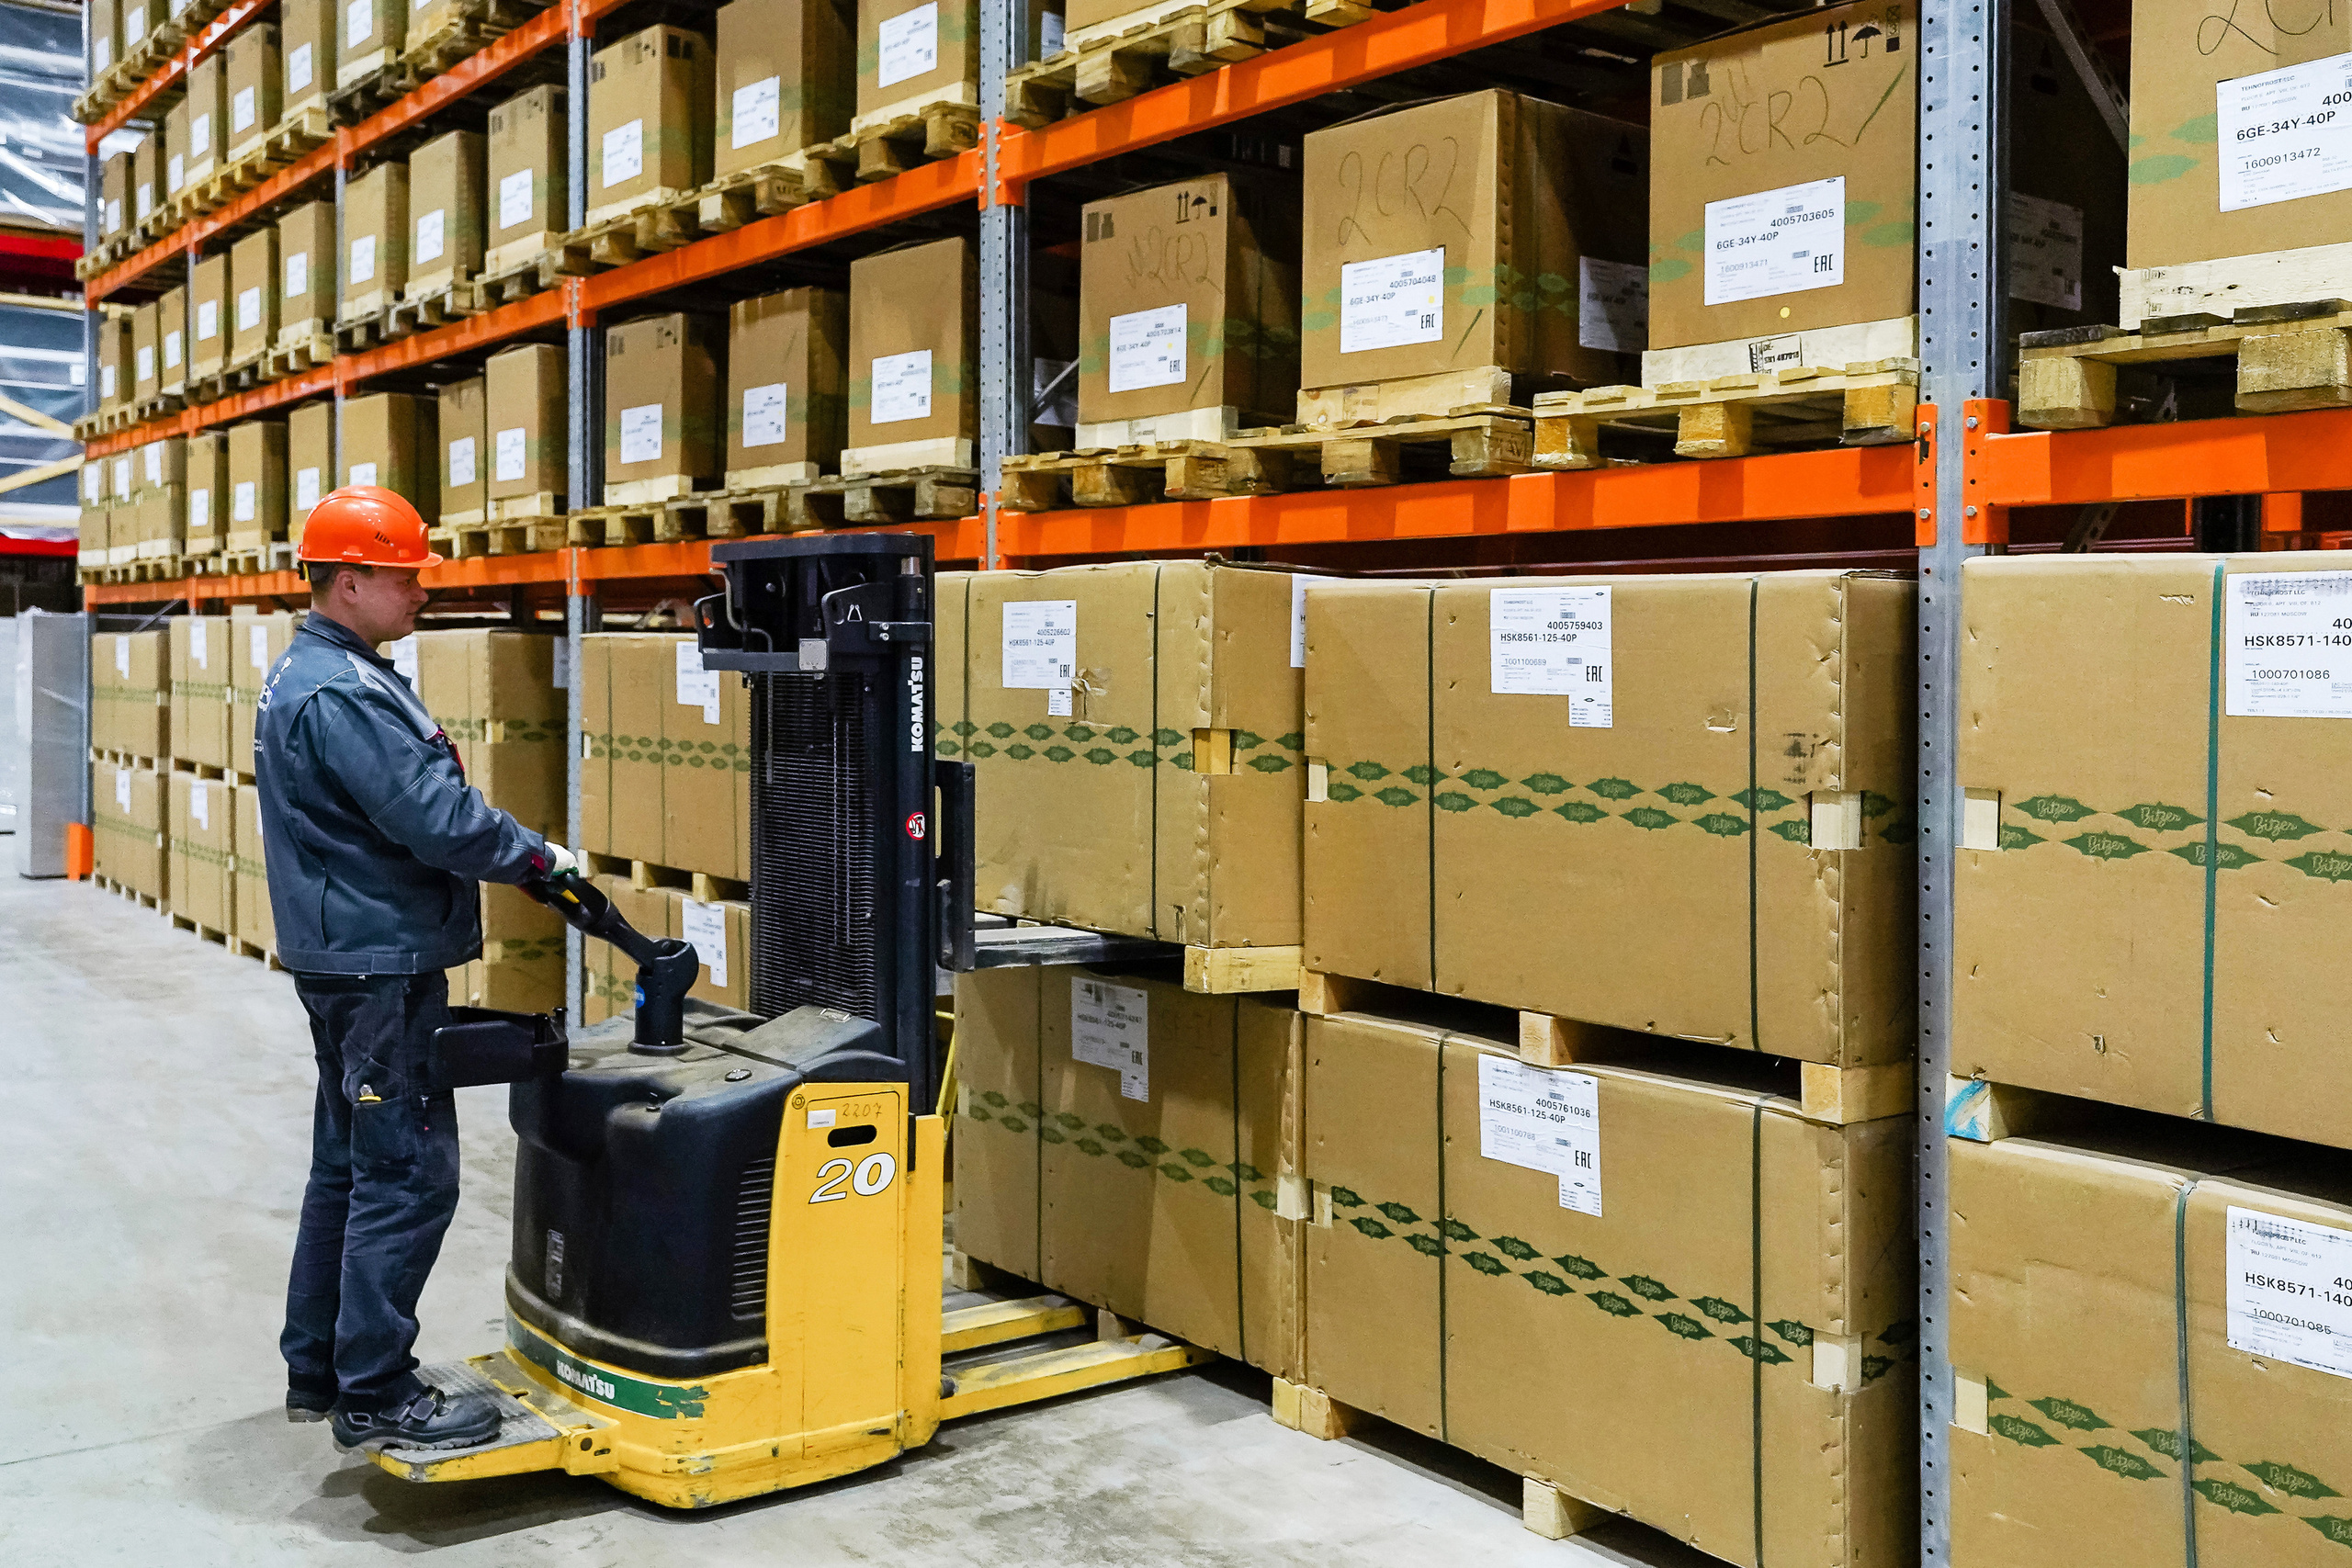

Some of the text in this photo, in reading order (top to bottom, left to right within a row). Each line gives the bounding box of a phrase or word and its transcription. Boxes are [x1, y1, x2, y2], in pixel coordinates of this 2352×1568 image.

[2236, 110, 2335, 141] 6GE-34Y-40P
[2245, 147, 2321, 170] 1600913472
[1770, 209, 1835, 227] 4005703605
[1716, 231, 1779, 250] 6GE-34Y-40P
[1547, 621, 1603, 630] 4005759403
[1500, 633, 1577, 642] HSK8561-125-40P
[2245, 635, 2352, 647] HSK8571-140
[2253, 670, 2330, 680] 1000701086
[908, 656, 924, 752] KOMATSU
[2037, 799, 2075, 818] Bitzer
[2141, 807, 2182, 827] Bitzer
[2253, 815, 2298, 836] Bitzer
[2086, 835, 2128, 855] Bitzer
[2195, 845, 2236, 863] Bzer
[2312, 854, 2352, 876] Bitze
[842, 1102, 882, 1118] 2207
[1489, 1099, 1566, 1123] HSK8561-125-40P
[1535, 1098, 1591, 1118] 4005761036
[808, 1152, 897, 1204] 20
[2245, 1272, 2352, 1306] HSK8571-140
[556, 1359, 615, 1400] KOMATSU
[2269, 1466, 2314, 1492] Bitzer
